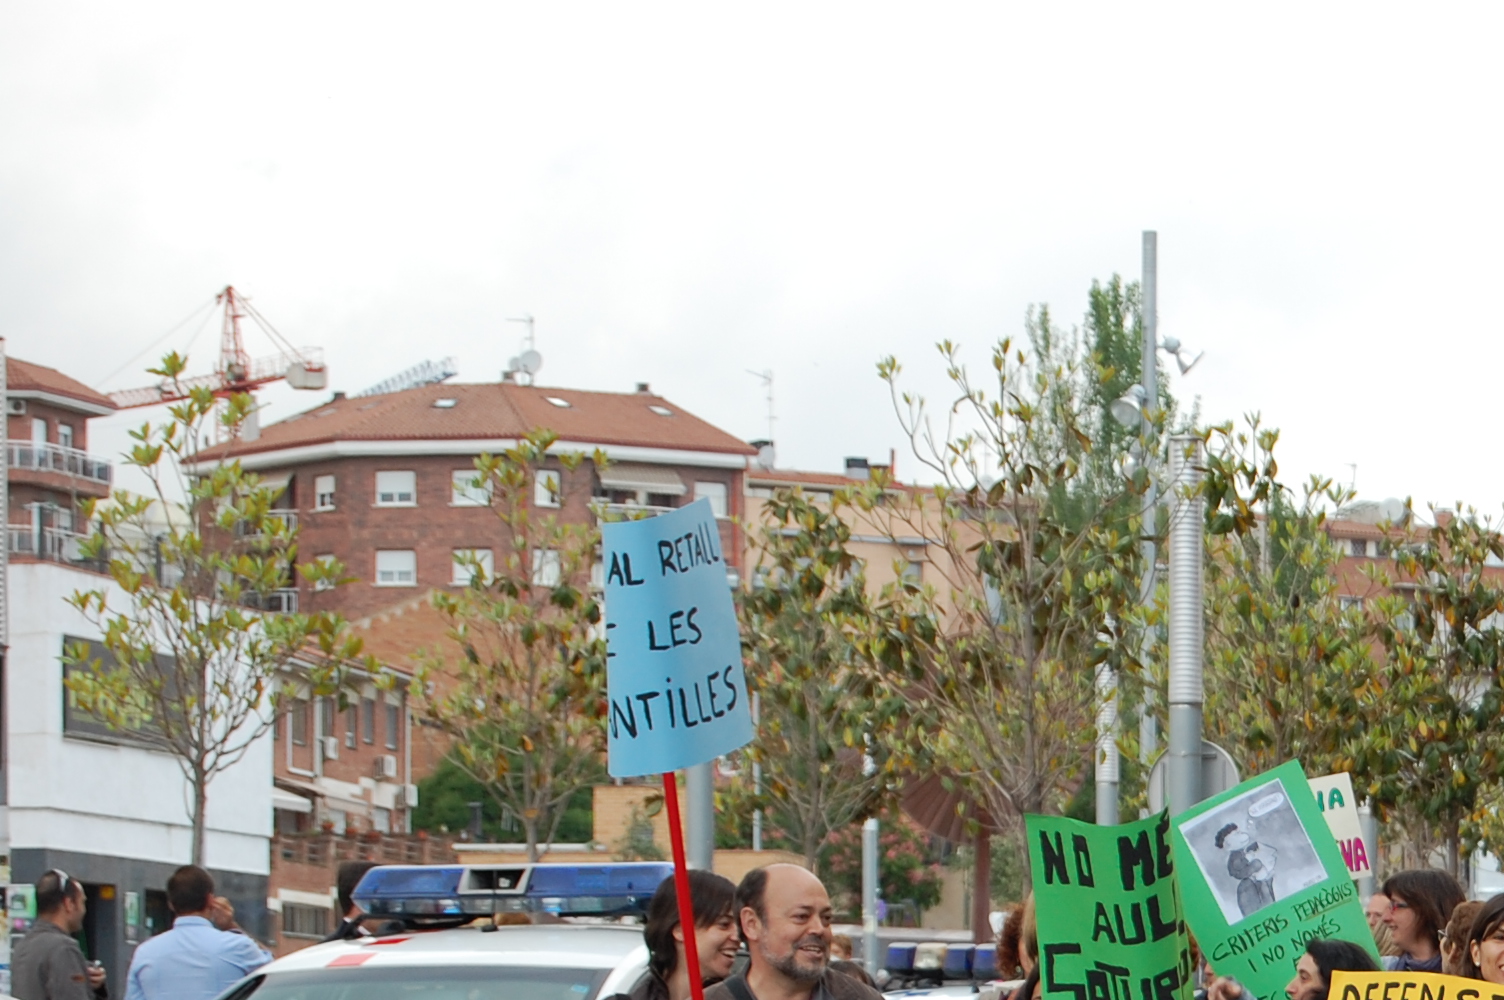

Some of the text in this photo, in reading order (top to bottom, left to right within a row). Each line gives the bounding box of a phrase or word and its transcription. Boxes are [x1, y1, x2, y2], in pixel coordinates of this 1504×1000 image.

[608, 522, 719, 586] AL RETALL
[648, 607, 702, 650] LES
[609, 665, 737, 739] NTILLES
[1039, 829, 1094, 887] NO
[1092, 888, 1184, 945] AUL
[1212, 914, 1289, 961] CRITERIS
[1247, 958, 1257, 973] I
[1262, 944, 1285, 966] NO
[1291, 914, 1341, 951] NOMÉS
